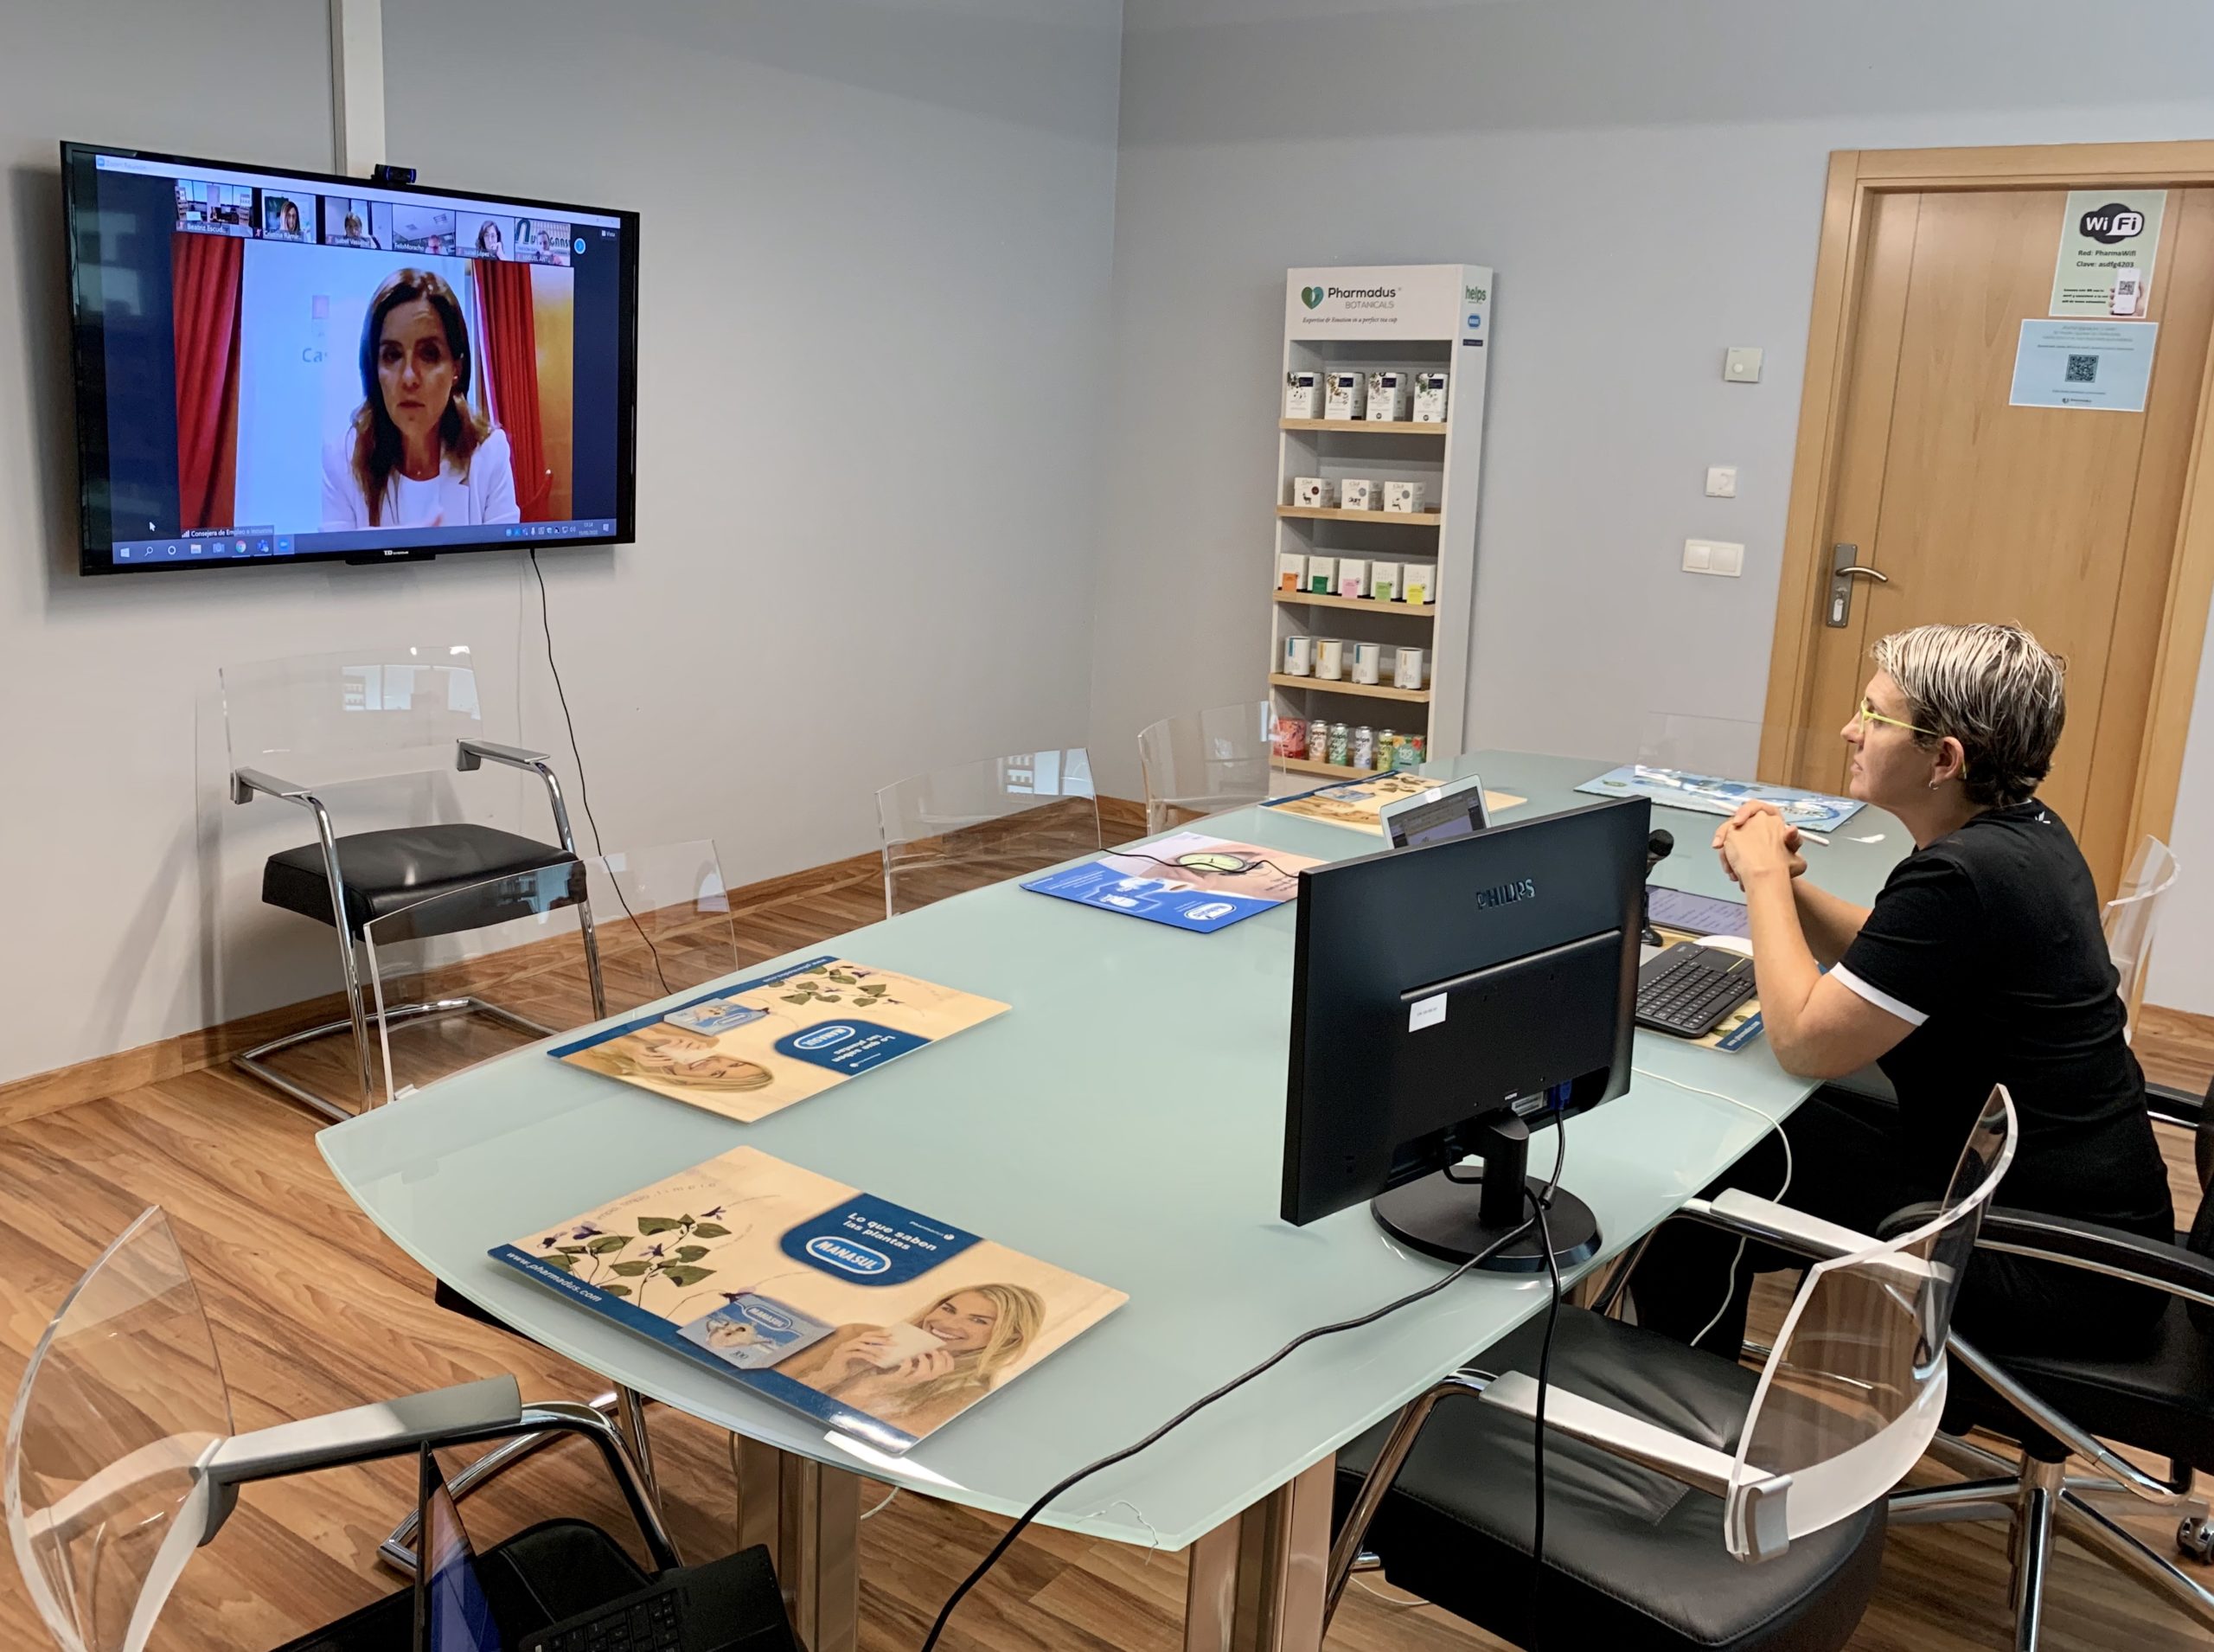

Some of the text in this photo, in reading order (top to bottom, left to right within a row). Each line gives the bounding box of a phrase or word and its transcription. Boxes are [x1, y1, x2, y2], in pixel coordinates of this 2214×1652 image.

[1328, 286, 1396, 299] Pharmadus
[1345, 301, 1394, 310] BOTANICALS
[1464, 285, 1487, 304] helps
[190, 529, 217, 539] Consejera
[218, 528, 225, 537] de
[1475, 878, 1537, 910] PHILIPS
[842, 1220, 911, 1251] las plantas
[847, 1212, 937, 1252] Lo que saben
[815, 1240, 880, 1271] MANASUL
[505, 1252, 603, 1303] www.pharmadus.com
